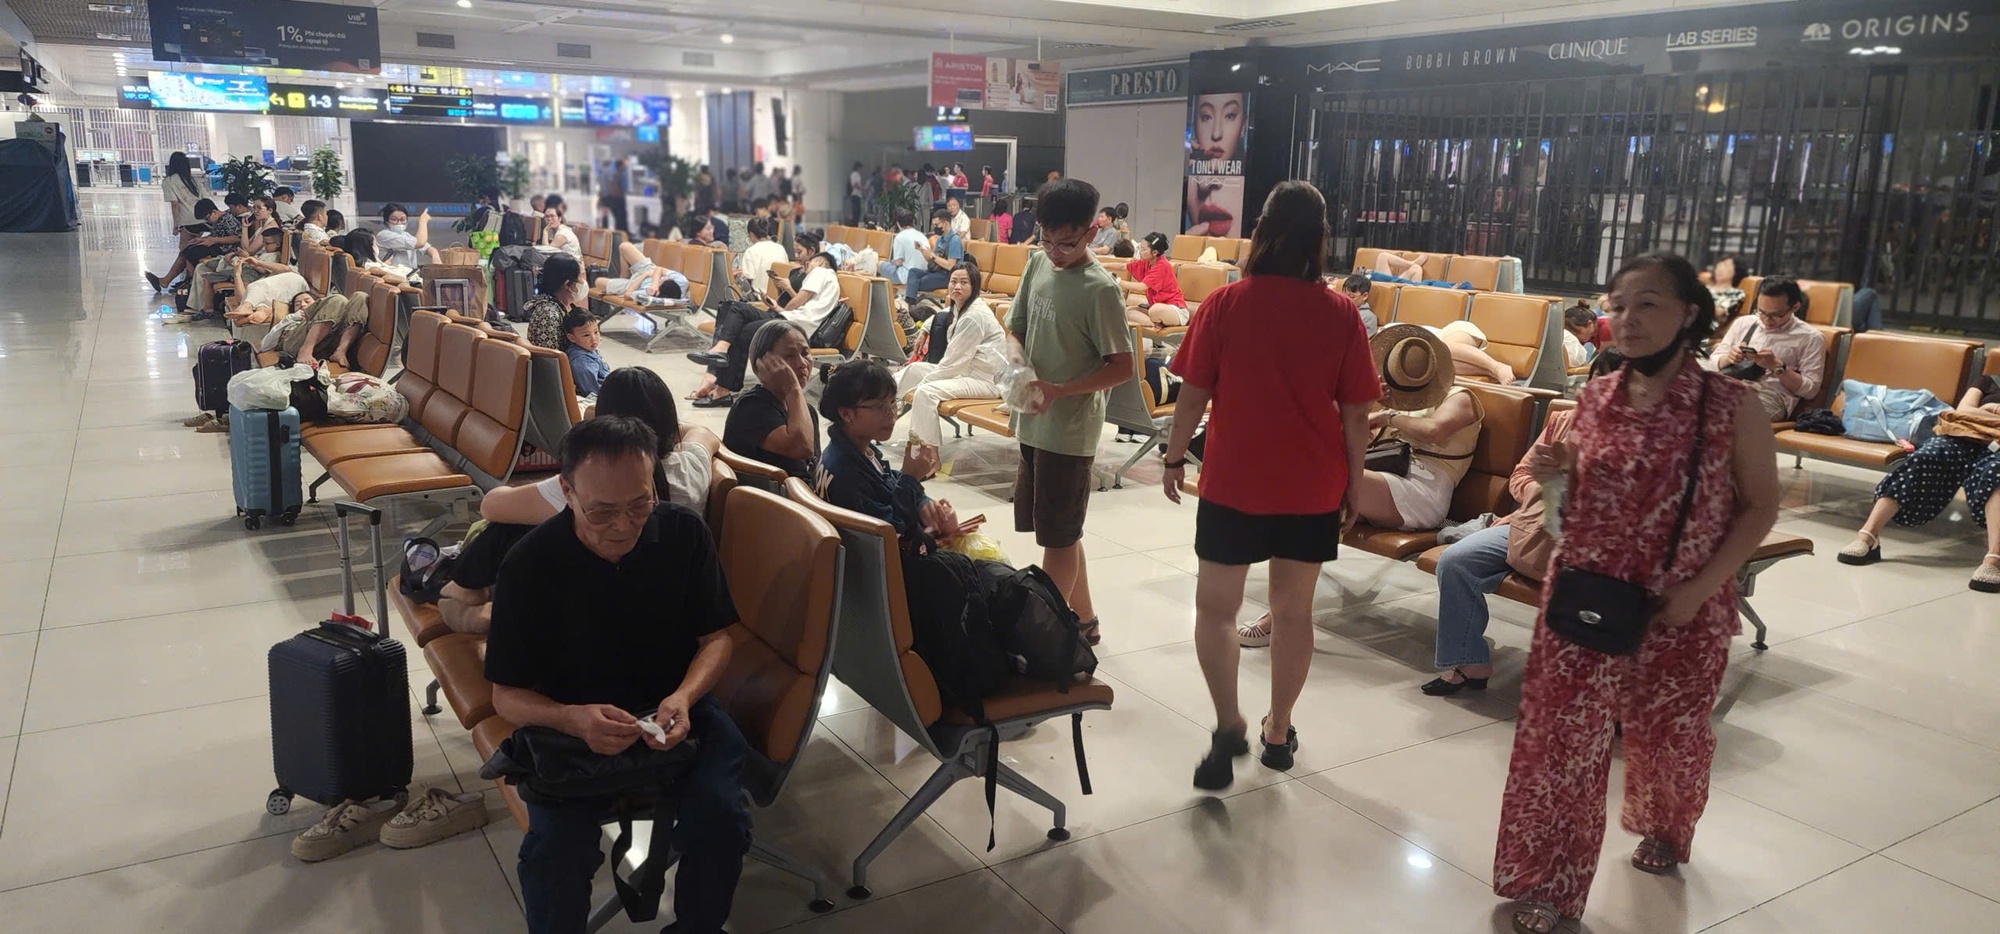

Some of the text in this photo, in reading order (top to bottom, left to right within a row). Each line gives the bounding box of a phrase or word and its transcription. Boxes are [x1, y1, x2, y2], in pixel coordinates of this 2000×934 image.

[277, 25, 303, 42] 1%
[1842, 11, 1970, 39] ORIGINS
[1666, 26, 1758, 47] LAB SERIES
[1406, 47, 1518, 70] BOBBI BROWN
[1549, 37, 1628, 60] CLINIQUE
[945, 62, 982, 71] ARISTON
[1110, 69, 1176, 95] PRESTO
[308, 94, 332, 108] 1-3
[1196, 160, 1216, 174] ONLY
[1217, 160, 1242, 174] WEAR
